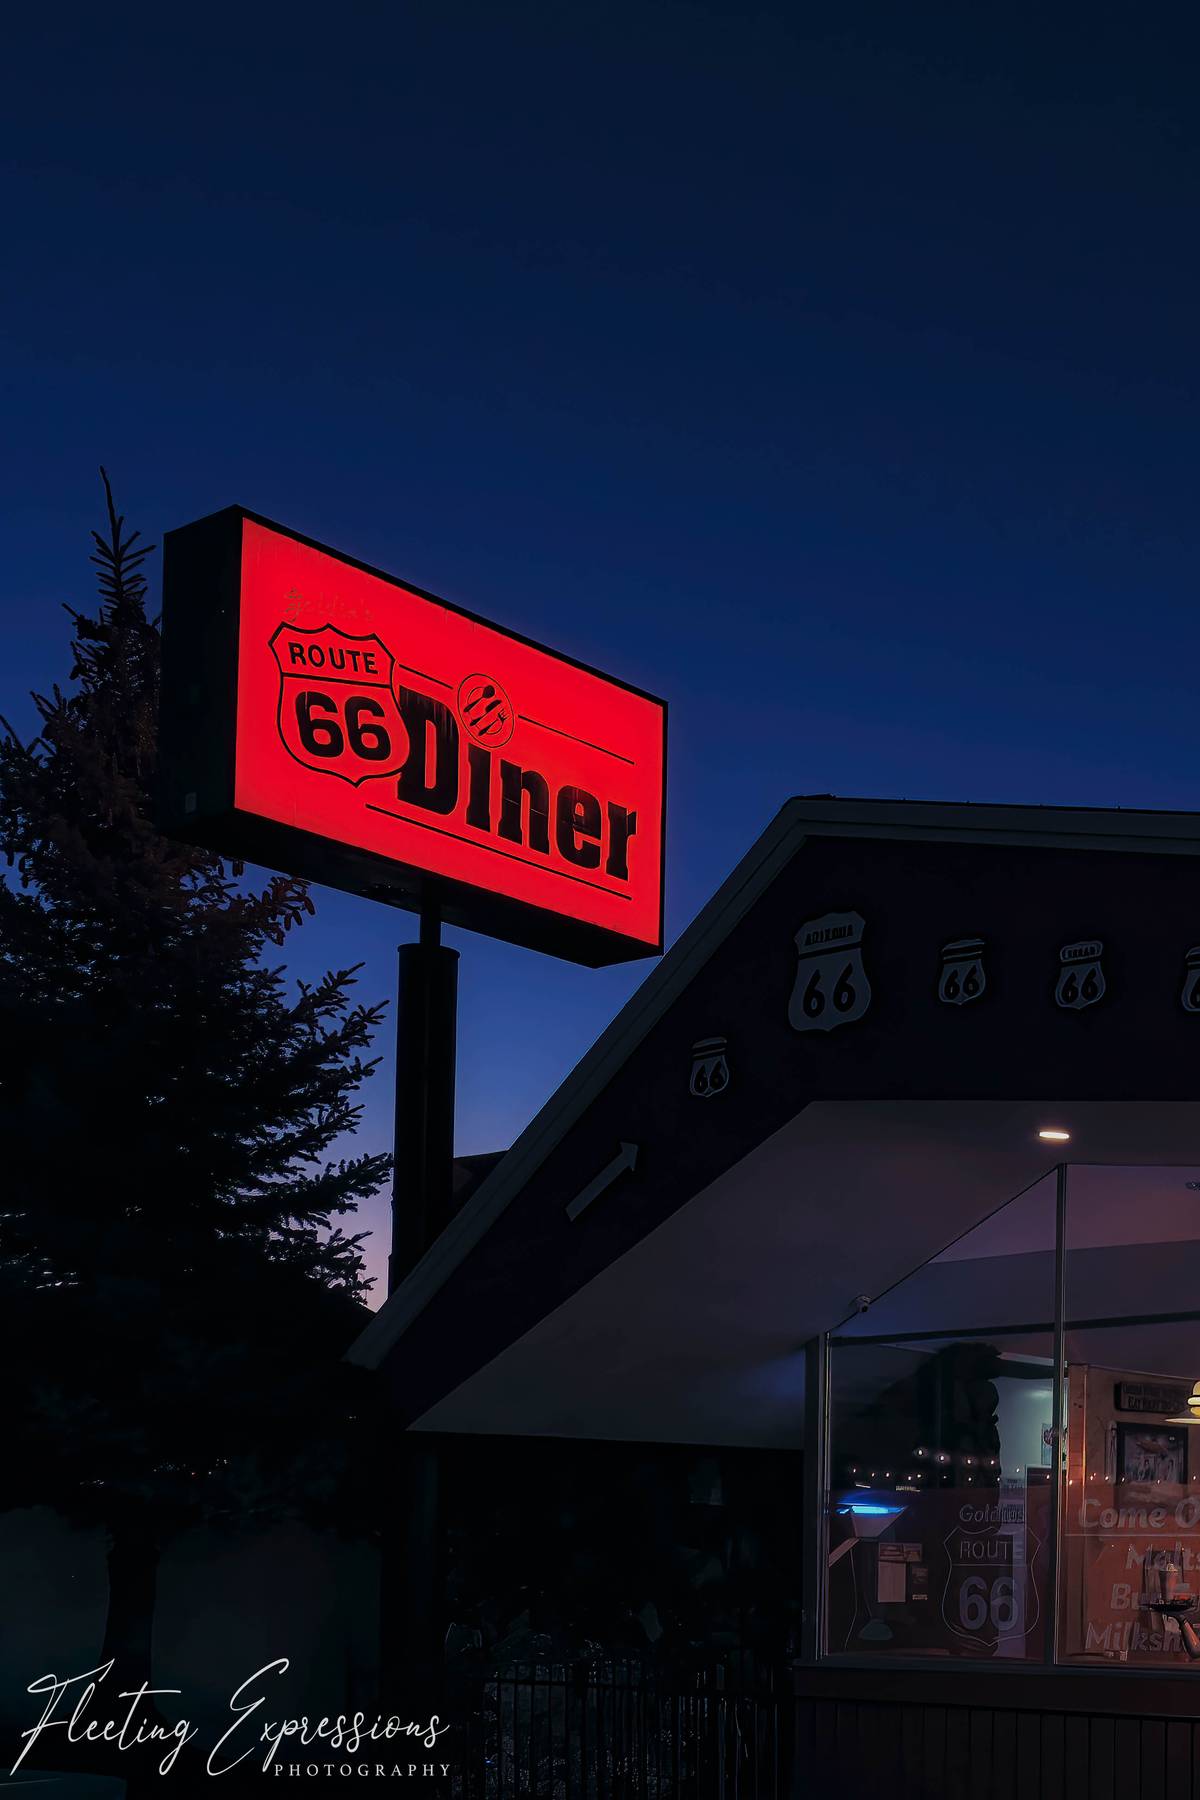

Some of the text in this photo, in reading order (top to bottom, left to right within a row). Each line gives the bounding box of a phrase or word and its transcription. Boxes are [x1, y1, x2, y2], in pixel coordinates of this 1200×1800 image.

[288, 642, 379, 675] ROUTE
[294, 690, 392, 762] 66
[397, 685, 638, 882] Diner
[803, 963, 856, 1018] 66
[944, 965, 980, 1000] 66
[1061, 967, 1098, 1003] 66
[695, 1060, 725, 1094] 66
[1079, 1498, 1168, 1529] Come
[960, 1576, 1019, 1630] 66
